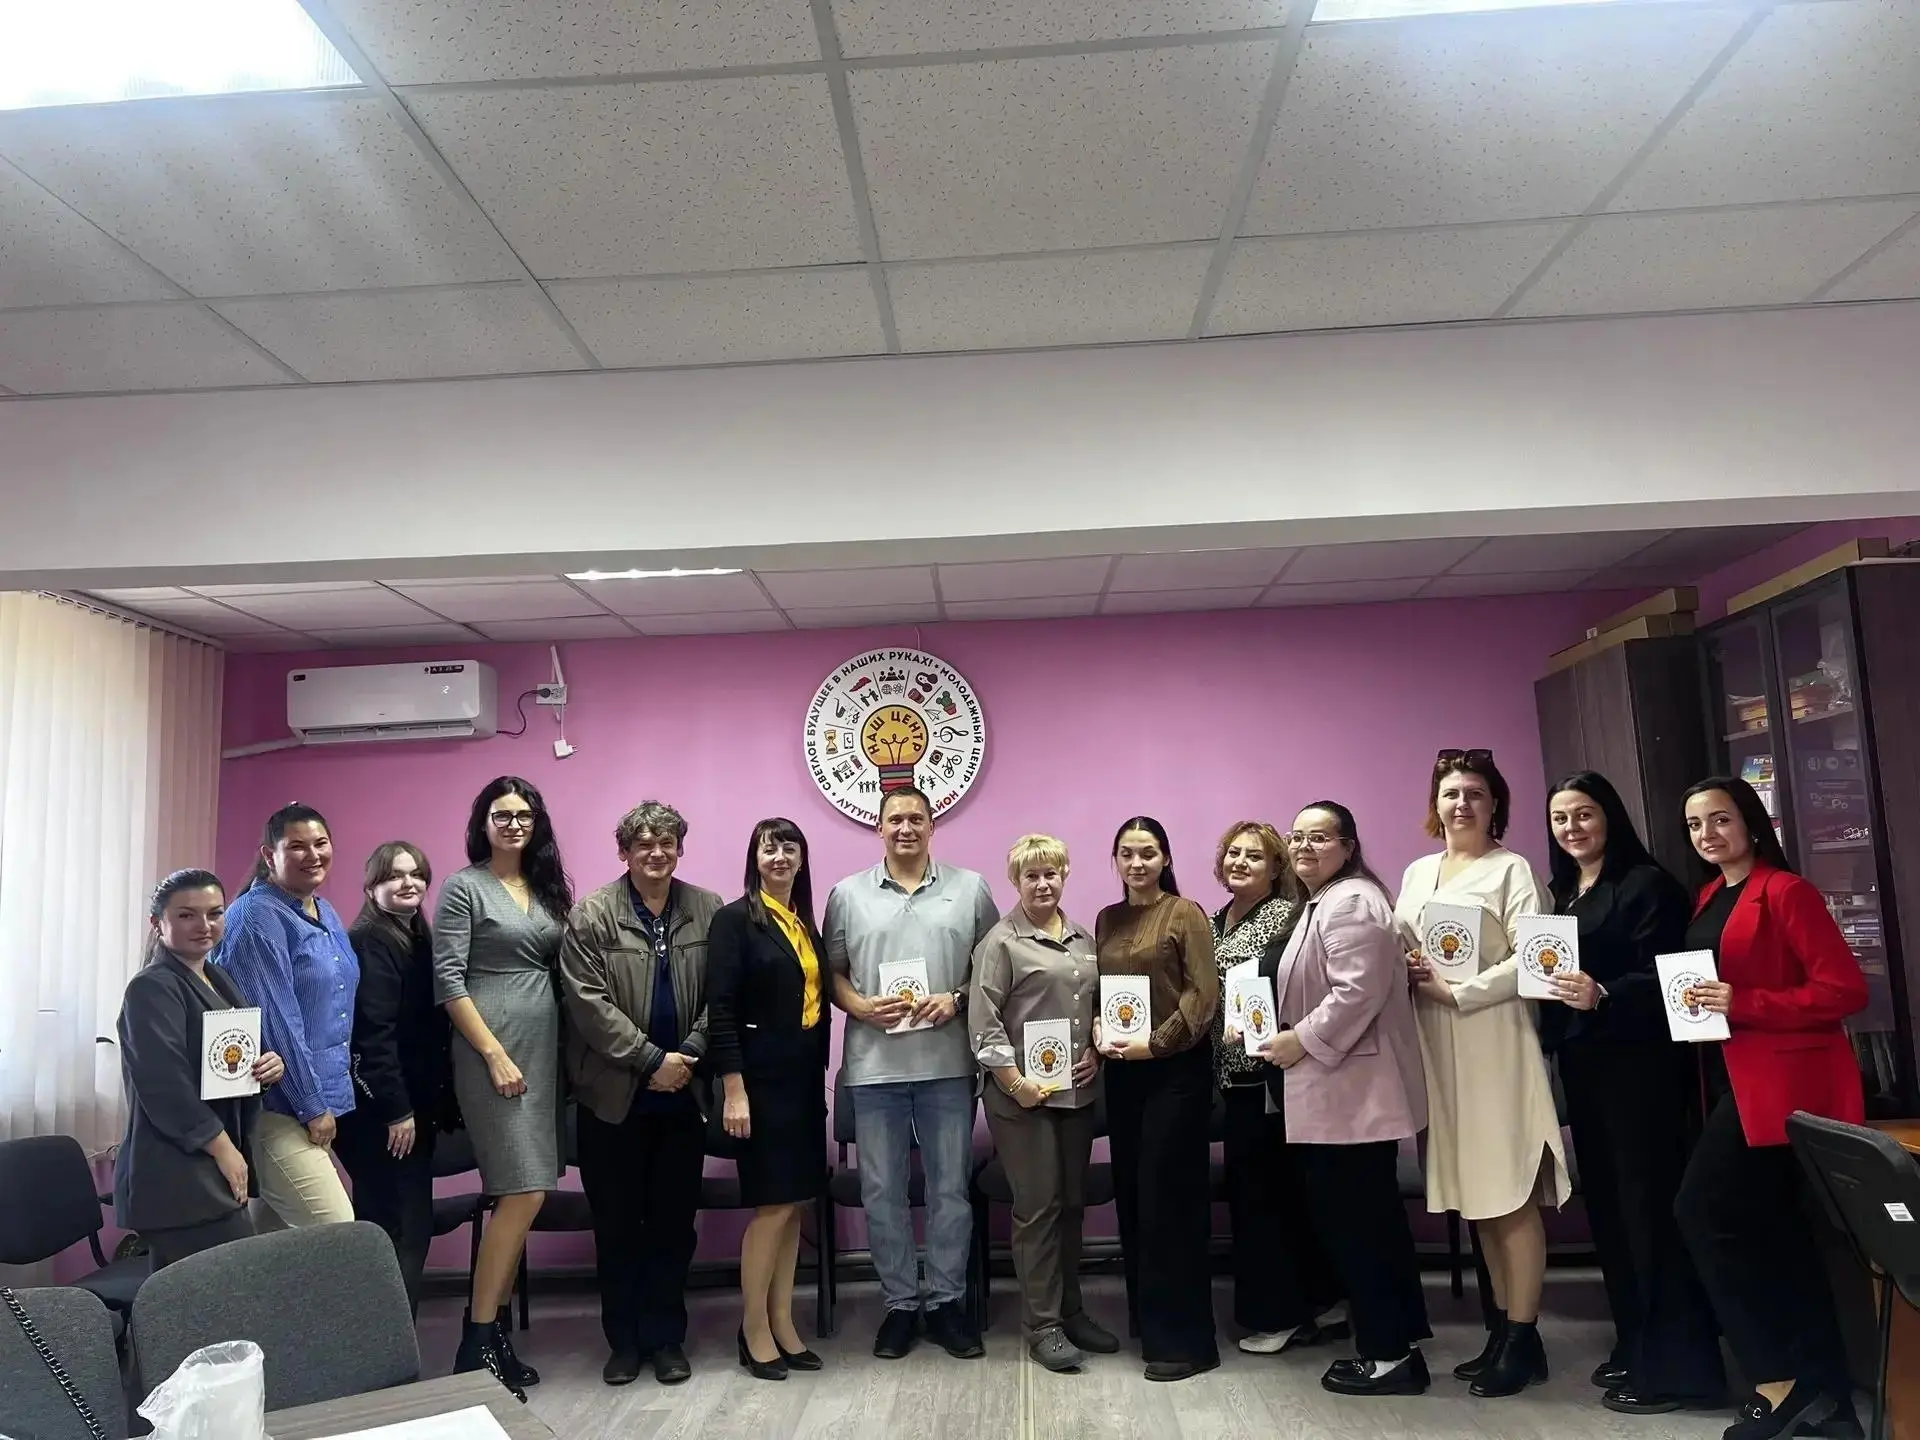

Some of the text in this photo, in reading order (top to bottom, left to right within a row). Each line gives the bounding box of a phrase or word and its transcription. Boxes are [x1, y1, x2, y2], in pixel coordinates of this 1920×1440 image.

[807, 651, 934, 791] СВЕТЛОЕ БУДУЩЕЕ В НАШИХ РУКАХ!
[867, 711, 924, 755] НАШ ЦЕНТР
[940, 667, 984, 783] МОЛОДЕЖНЫЙ ЦЕНТР
[836, 790, 959, 822] ЛУТУГИ АЙОН
